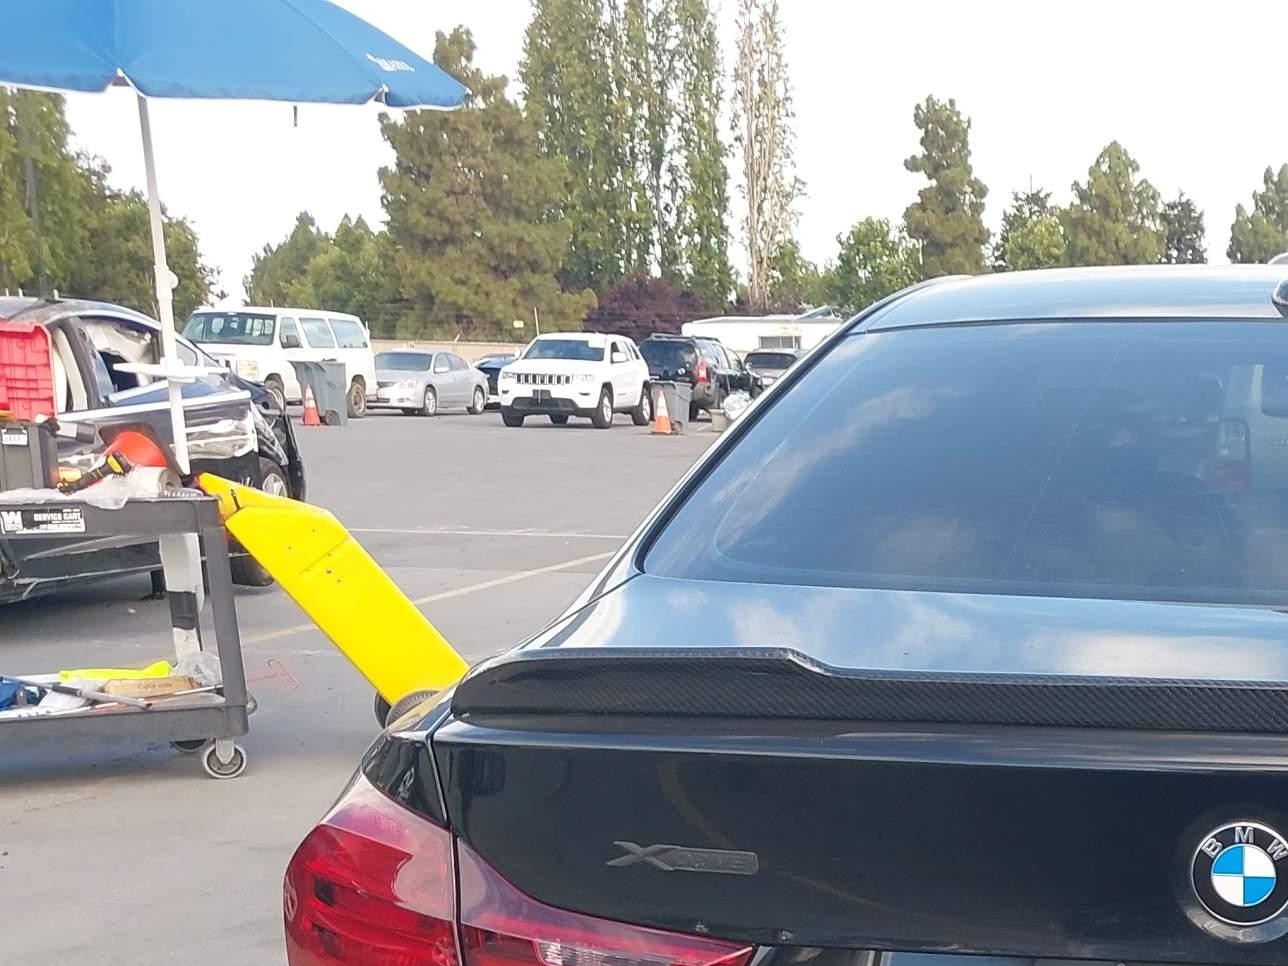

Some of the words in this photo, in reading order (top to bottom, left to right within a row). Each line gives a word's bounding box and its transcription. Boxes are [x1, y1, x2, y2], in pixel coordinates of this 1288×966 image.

[33, 513, 62, 522] SERVICE
[63, 512, 82, 521] CART
[1201, 826, 1288, 860] BMW
